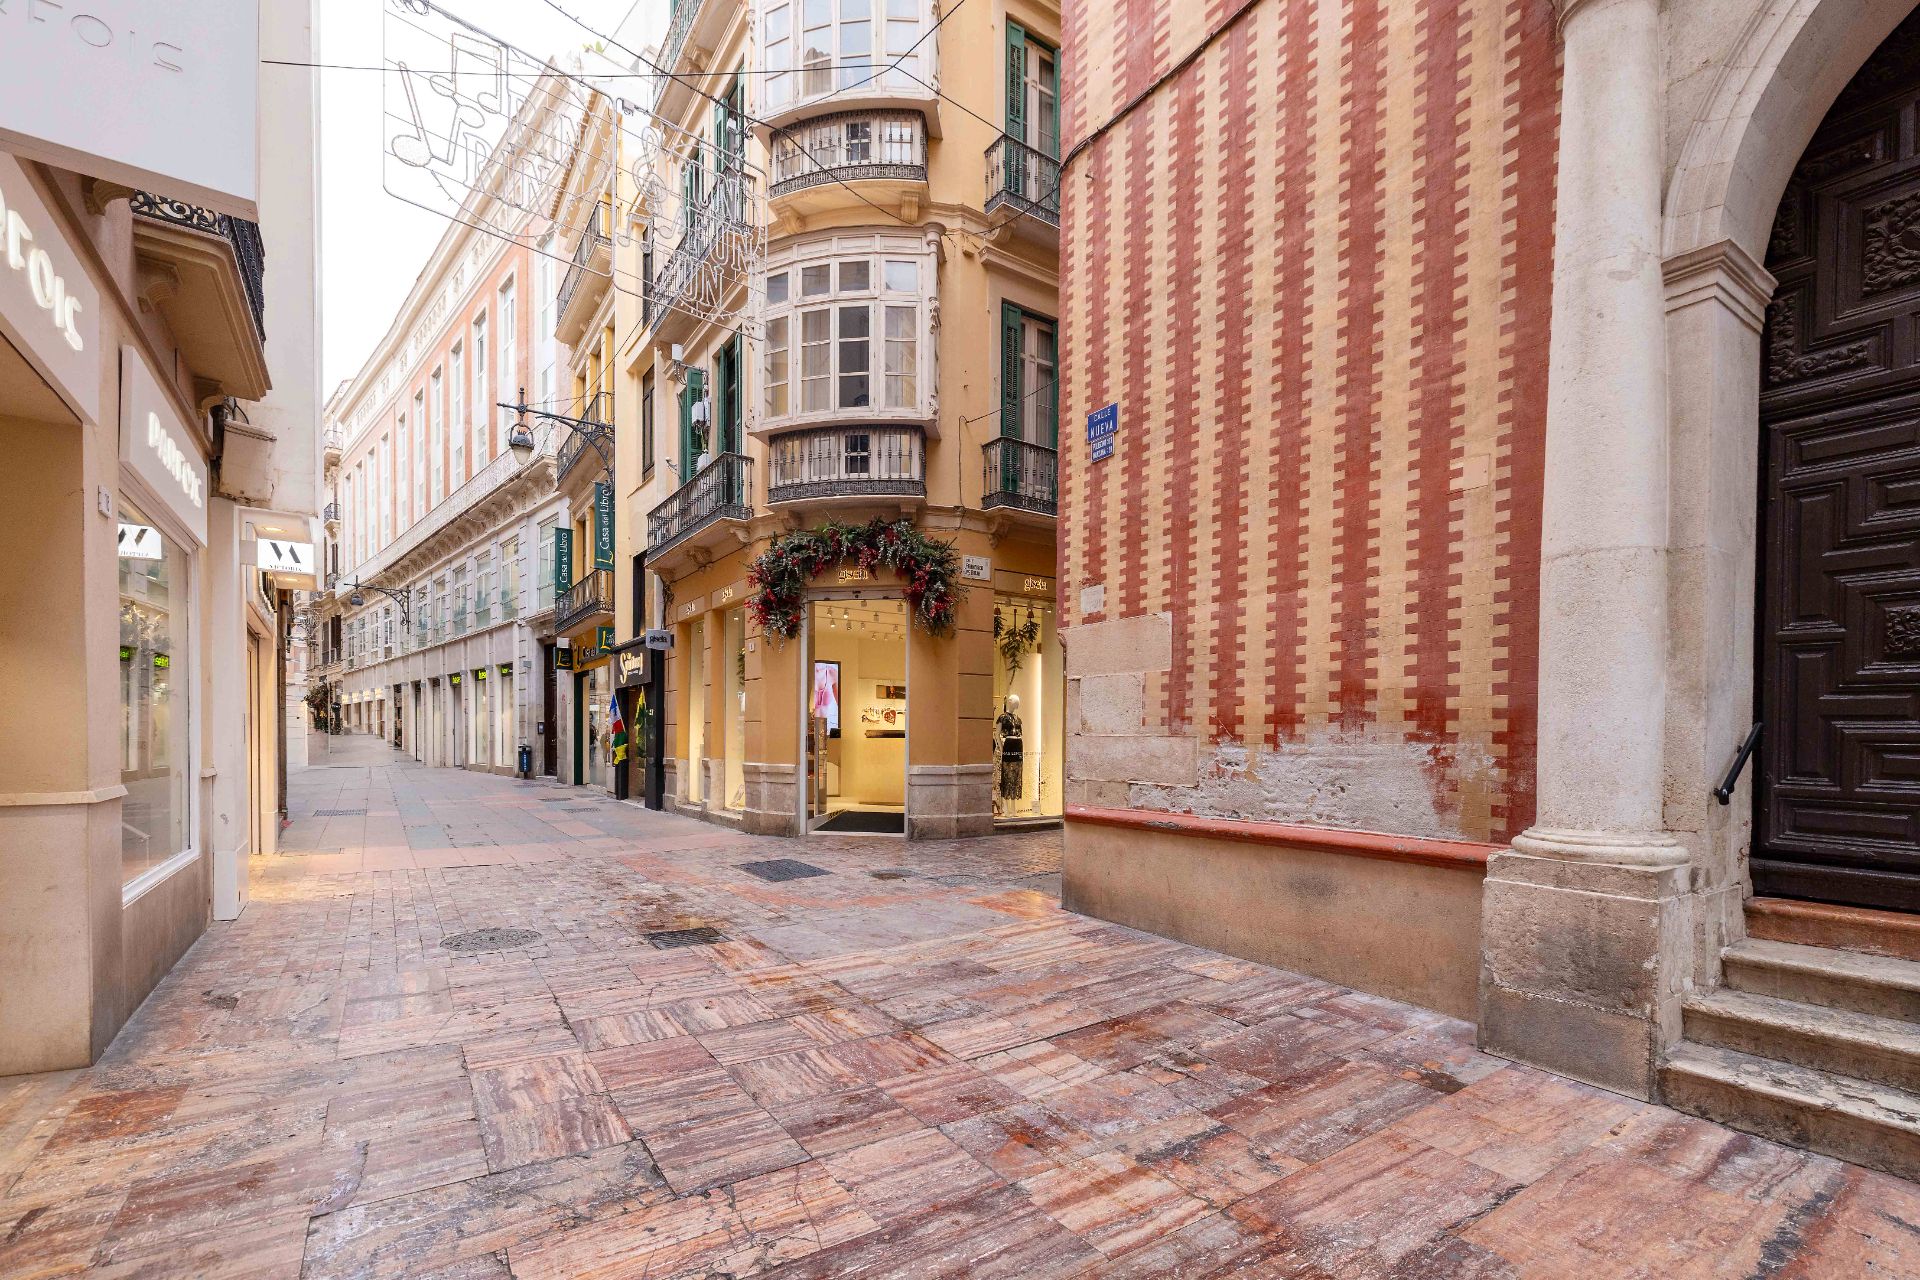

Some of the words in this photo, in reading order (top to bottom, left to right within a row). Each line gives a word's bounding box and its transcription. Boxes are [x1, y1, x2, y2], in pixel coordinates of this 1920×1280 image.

[1093, 408, 1112, 422] CALLE
[1090, 419, 1114, 439] NUEVA
[599, 489, 610, 512] Libro
[602, 514, 610, 525] del
[559, 532, 568, 552] Libro
[599, 527, 610, 550] Casa
[559, 564, 568, 583] Casa
